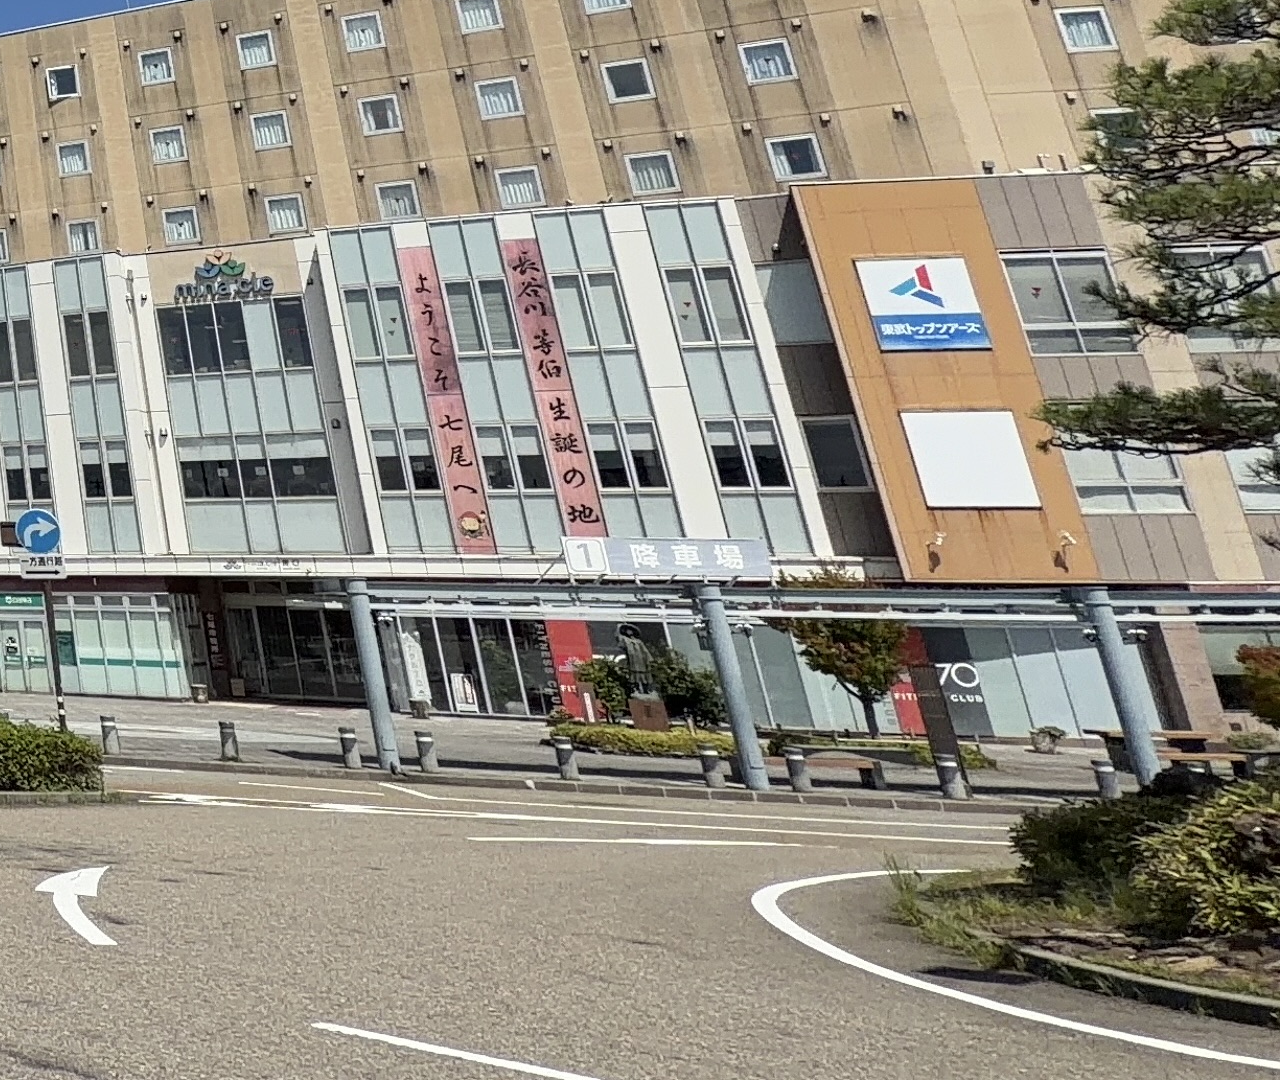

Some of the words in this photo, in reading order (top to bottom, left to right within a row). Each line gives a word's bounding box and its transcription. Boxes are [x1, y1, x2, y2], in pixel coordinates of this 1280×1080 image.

[576, 543, 594, 568] 1
[629, 544, 744, 569] 降車場
[950, 693, 984, 703] CLUB
